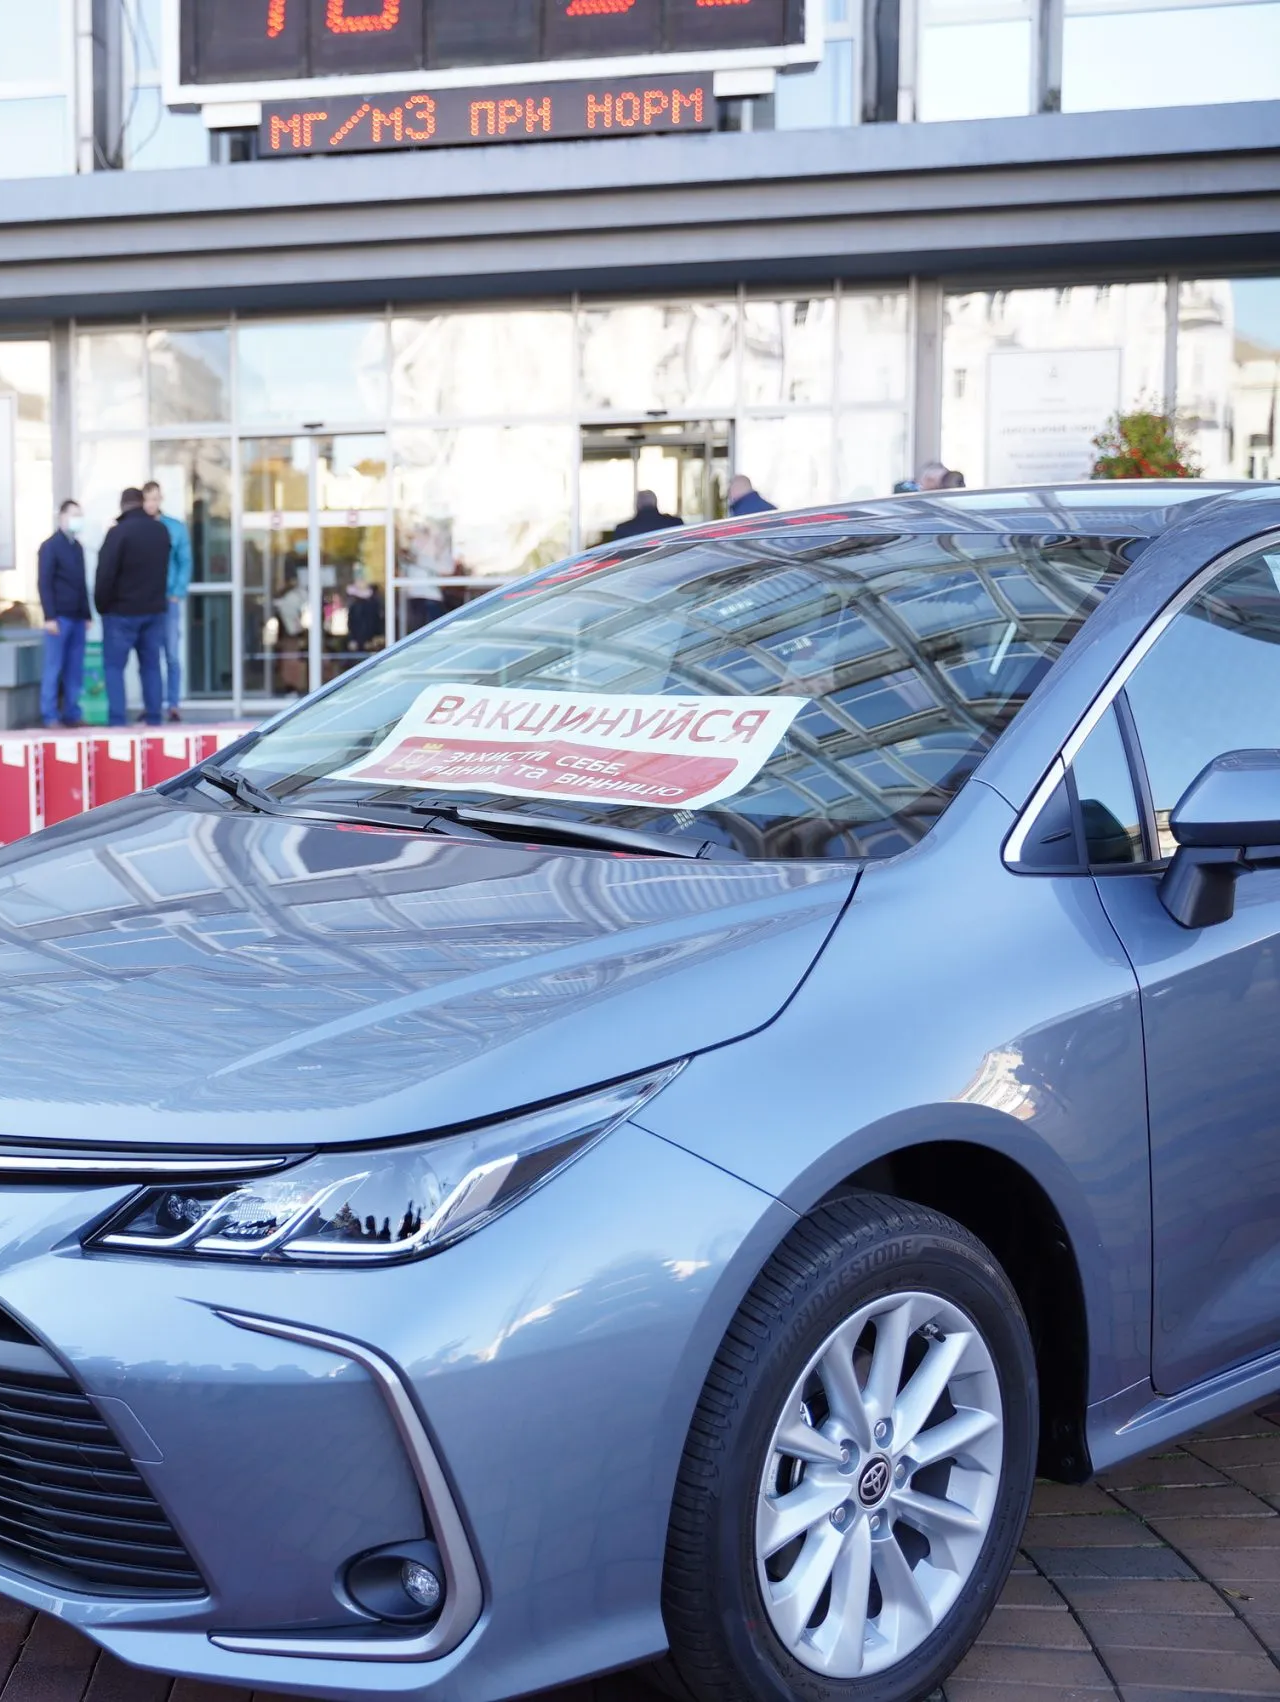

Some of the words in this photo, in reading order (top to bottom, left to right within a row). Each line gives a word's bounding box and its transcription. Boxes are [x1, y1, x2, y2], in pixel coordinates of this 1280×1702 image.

[425, 693, 771, 744] ВАКЦИНУЙСЯ
[422, 762, 510, 776] РІДНИХ
[517, 764, 549, 780] та
[553, 772, 685, 797] ВІННИЦЮ
[443, 750, 551, 763] ЗАХИСТИ
[555, 755, 626, 776] СЕБЕ,
